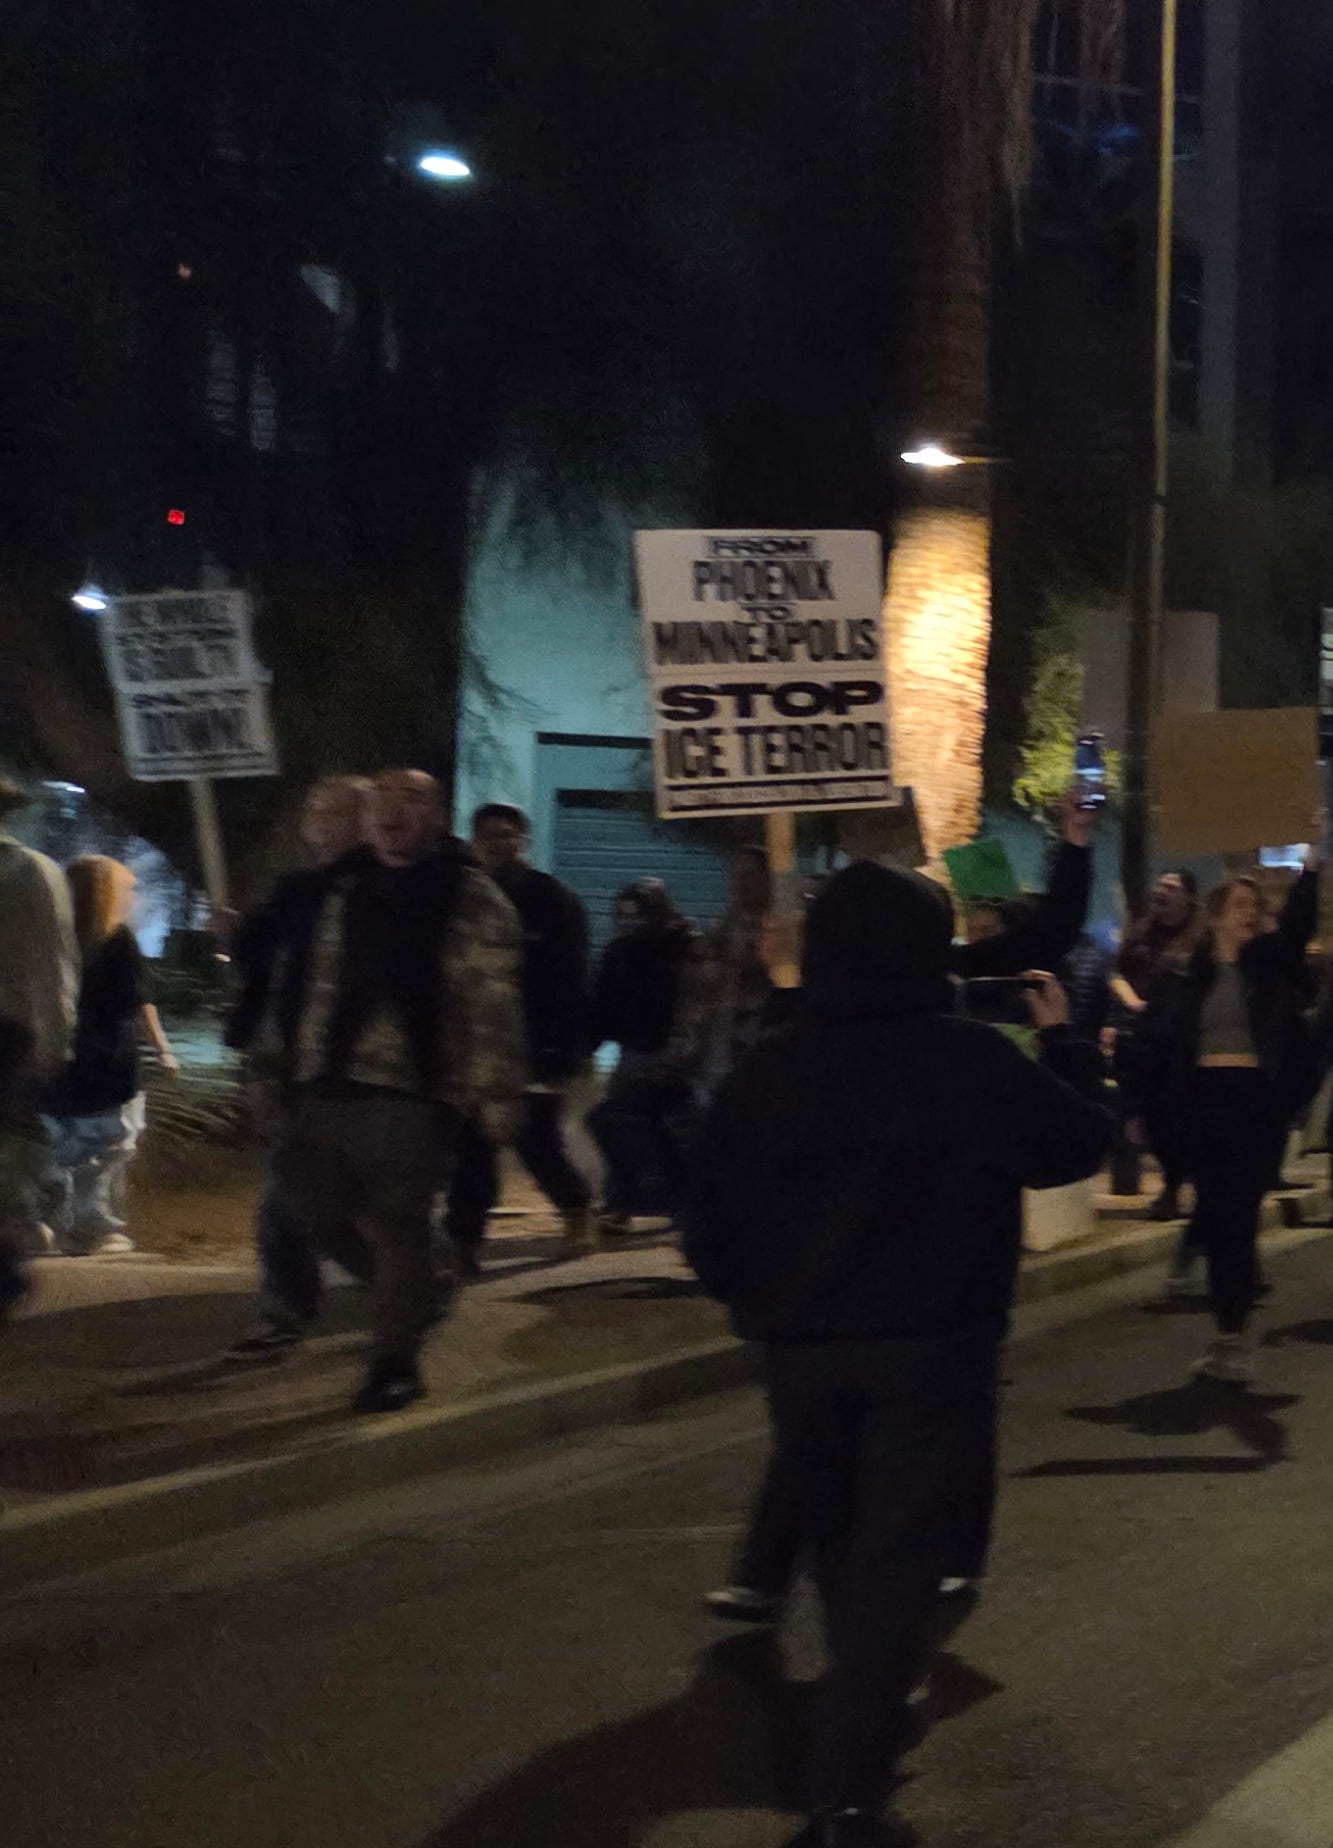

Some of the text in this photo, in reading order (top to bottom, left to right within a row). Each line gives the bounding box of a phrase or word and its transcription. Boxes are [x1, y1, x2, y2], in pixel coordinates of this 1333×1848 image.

[711, 537, 812, 557] FROM
[693, 560, 833, 601] PHOENIX
[740, 602, 791, 621] TO
[652, 617, 878, 666] MINNEAPOLIS
[658, 679, 885, 722] STOP
[663, 721, 888, 778] ICE TERROR
